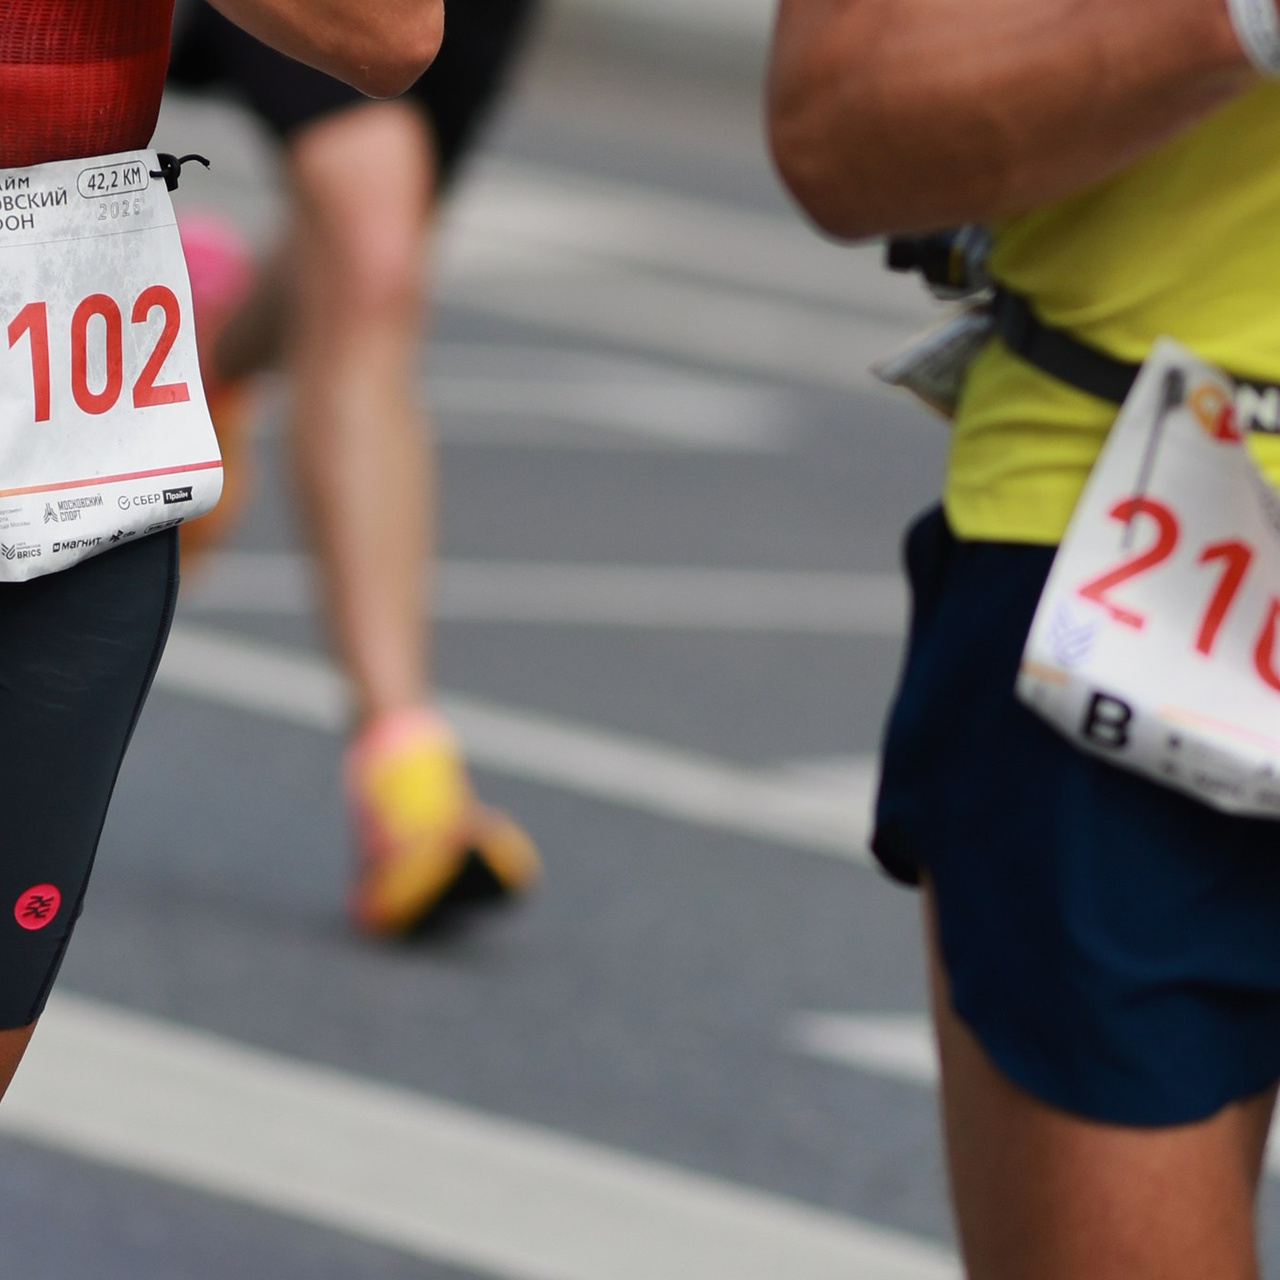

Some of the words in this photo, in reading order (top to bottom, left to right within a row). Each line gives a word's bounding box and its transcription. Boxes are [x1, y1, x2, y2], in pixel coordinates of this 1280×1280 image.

[87, 170, 119, 193] 42,2
[57, 493, 103, 510] МОСКОВСКИЙ
[133, 493, 161, 506] СБЕР
[59, 509, 82, 522] СПОРТ
[17, 548, 42, 559] BRICS
